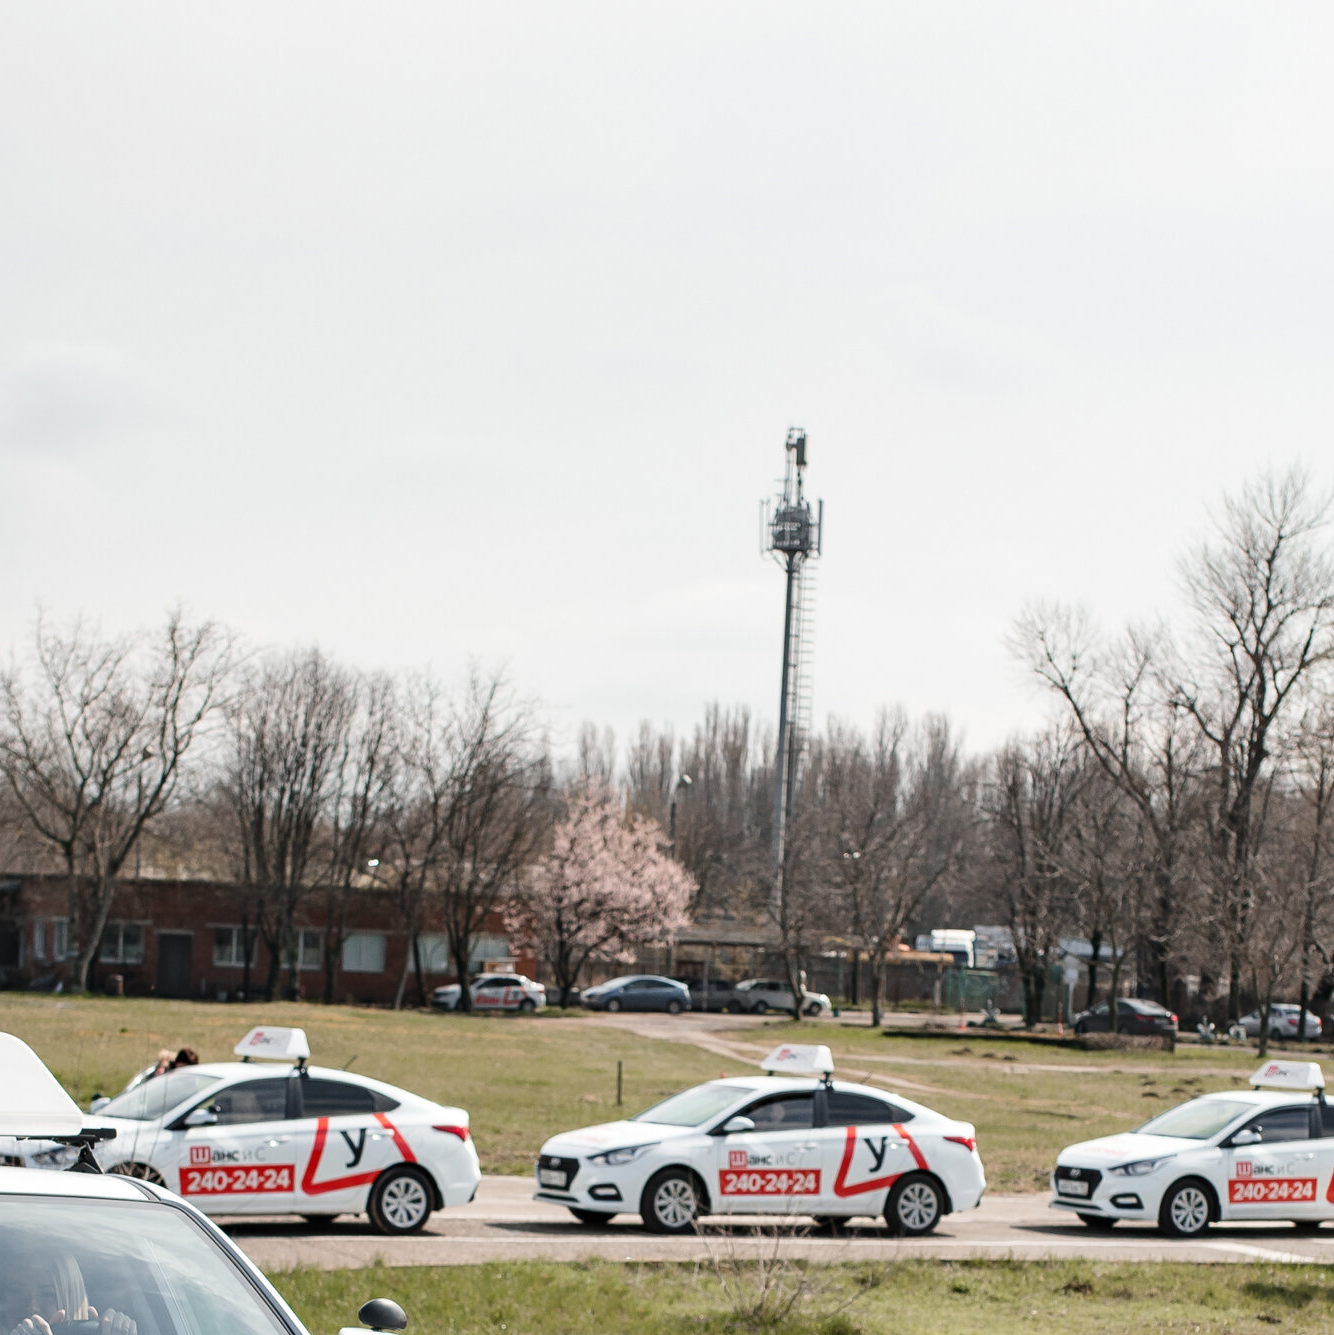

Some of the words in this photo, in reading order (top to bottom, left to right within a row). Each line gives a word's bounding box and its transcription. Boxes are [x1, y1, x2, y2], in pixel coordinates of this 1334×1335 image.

[340, 1128, 367, 1168] У
[864, 1136, 887, 1172] У
[188, 1169, 290, 1192] 240-24-24
[724, 1172, 816, 1193] 240-24-24
[1233, 1181, 1313, 1201] 240-24-24
